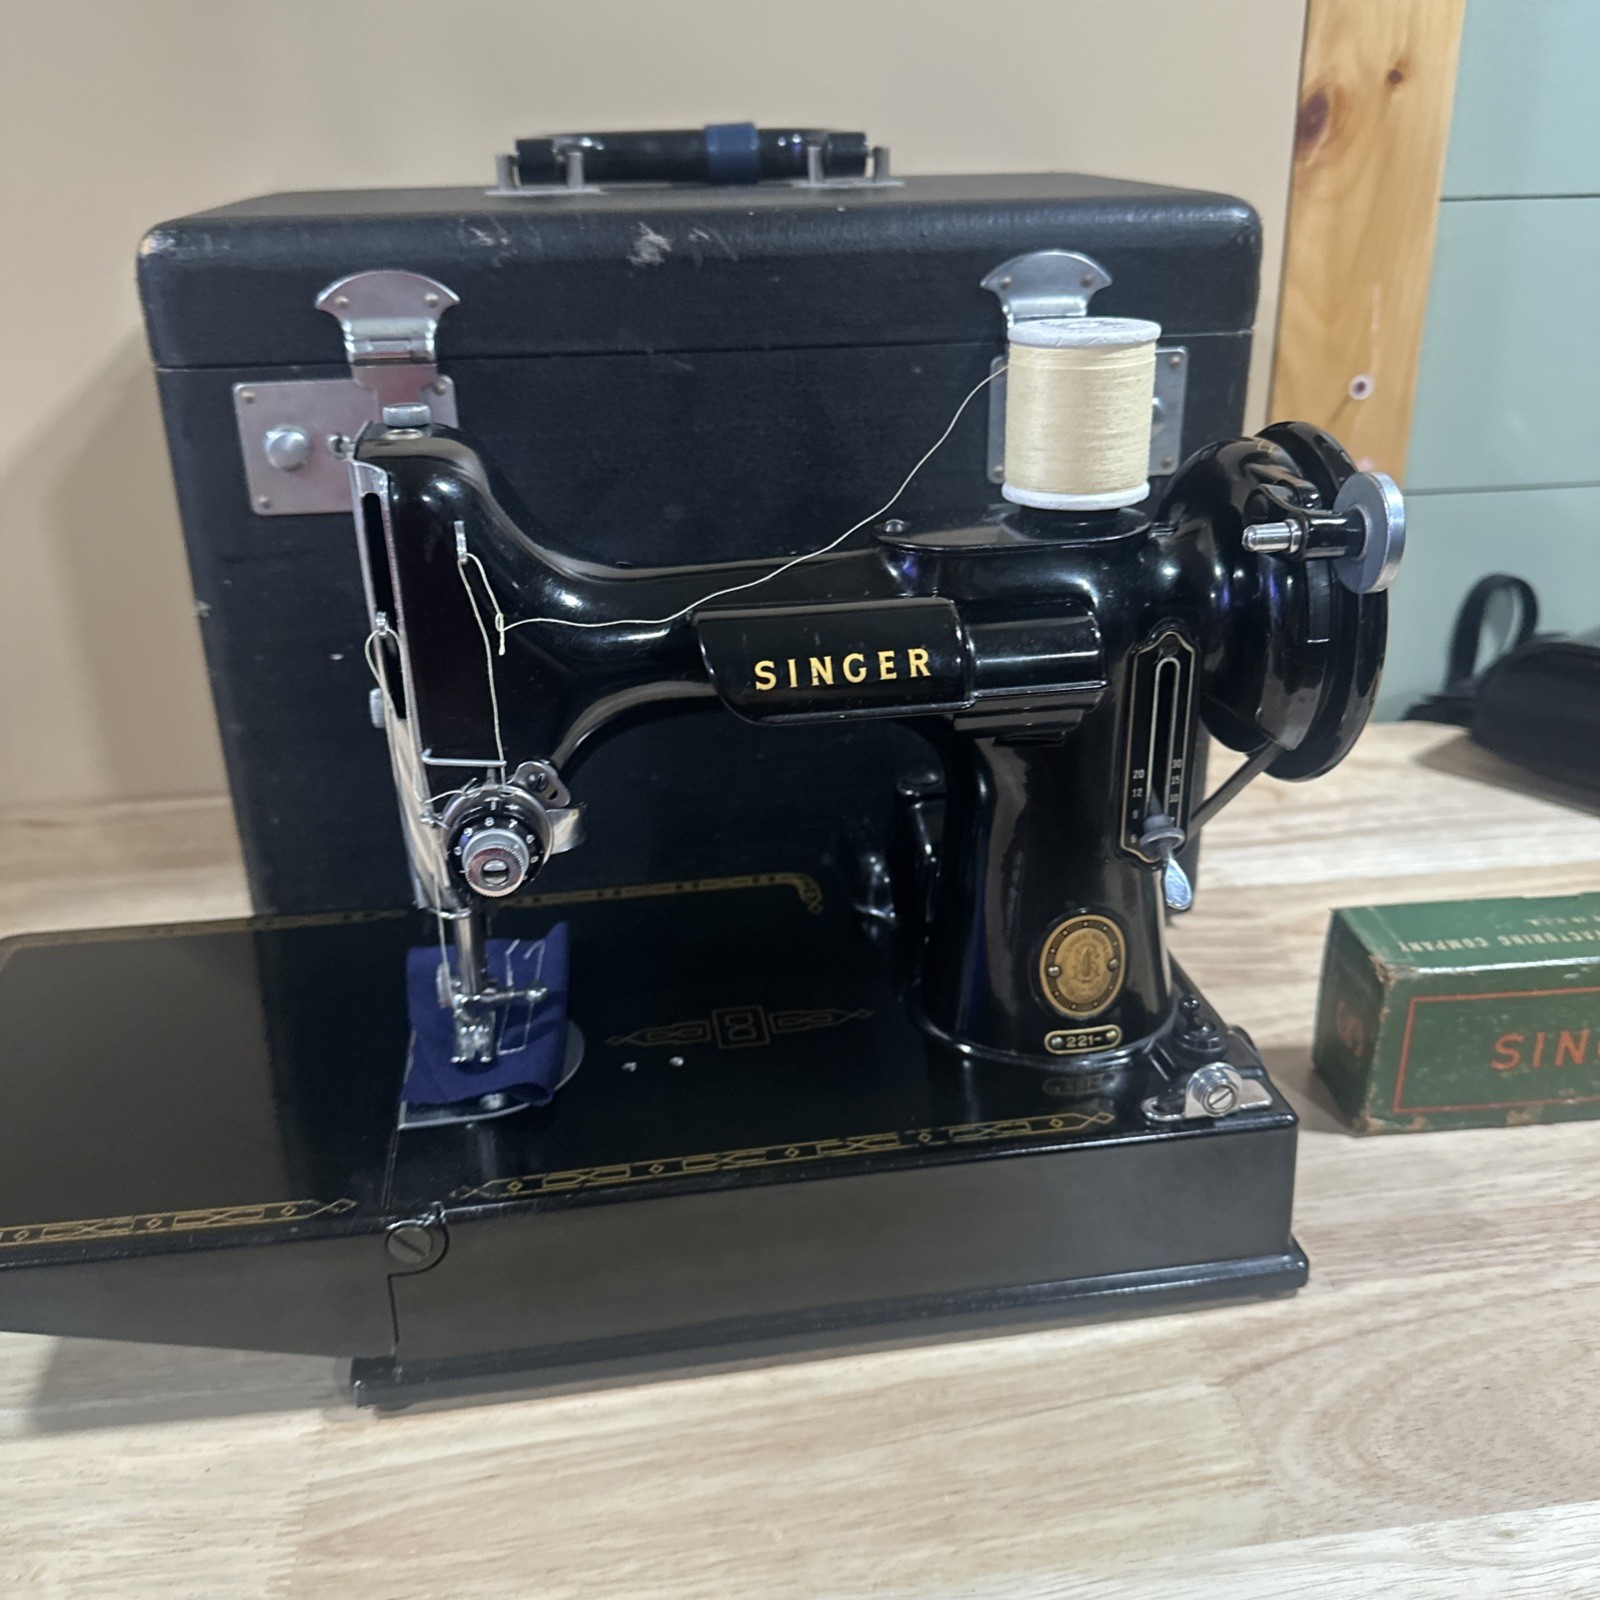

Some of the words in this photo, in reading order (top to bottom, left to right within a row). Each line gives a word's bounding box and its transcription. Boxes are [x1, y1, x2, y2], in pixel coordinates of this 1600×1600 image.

[754, 648, 931, 691] SINGER
[1133, 769, 1145, 779] 20
[1132, 788, 1143, 798] 12
[484, 816, 494, 826] 8
[508, 818, 518, 828] 7
[1397, 936, 1489, 953] COMPANY
[1491, 1028, 1600, 1070] SIN
